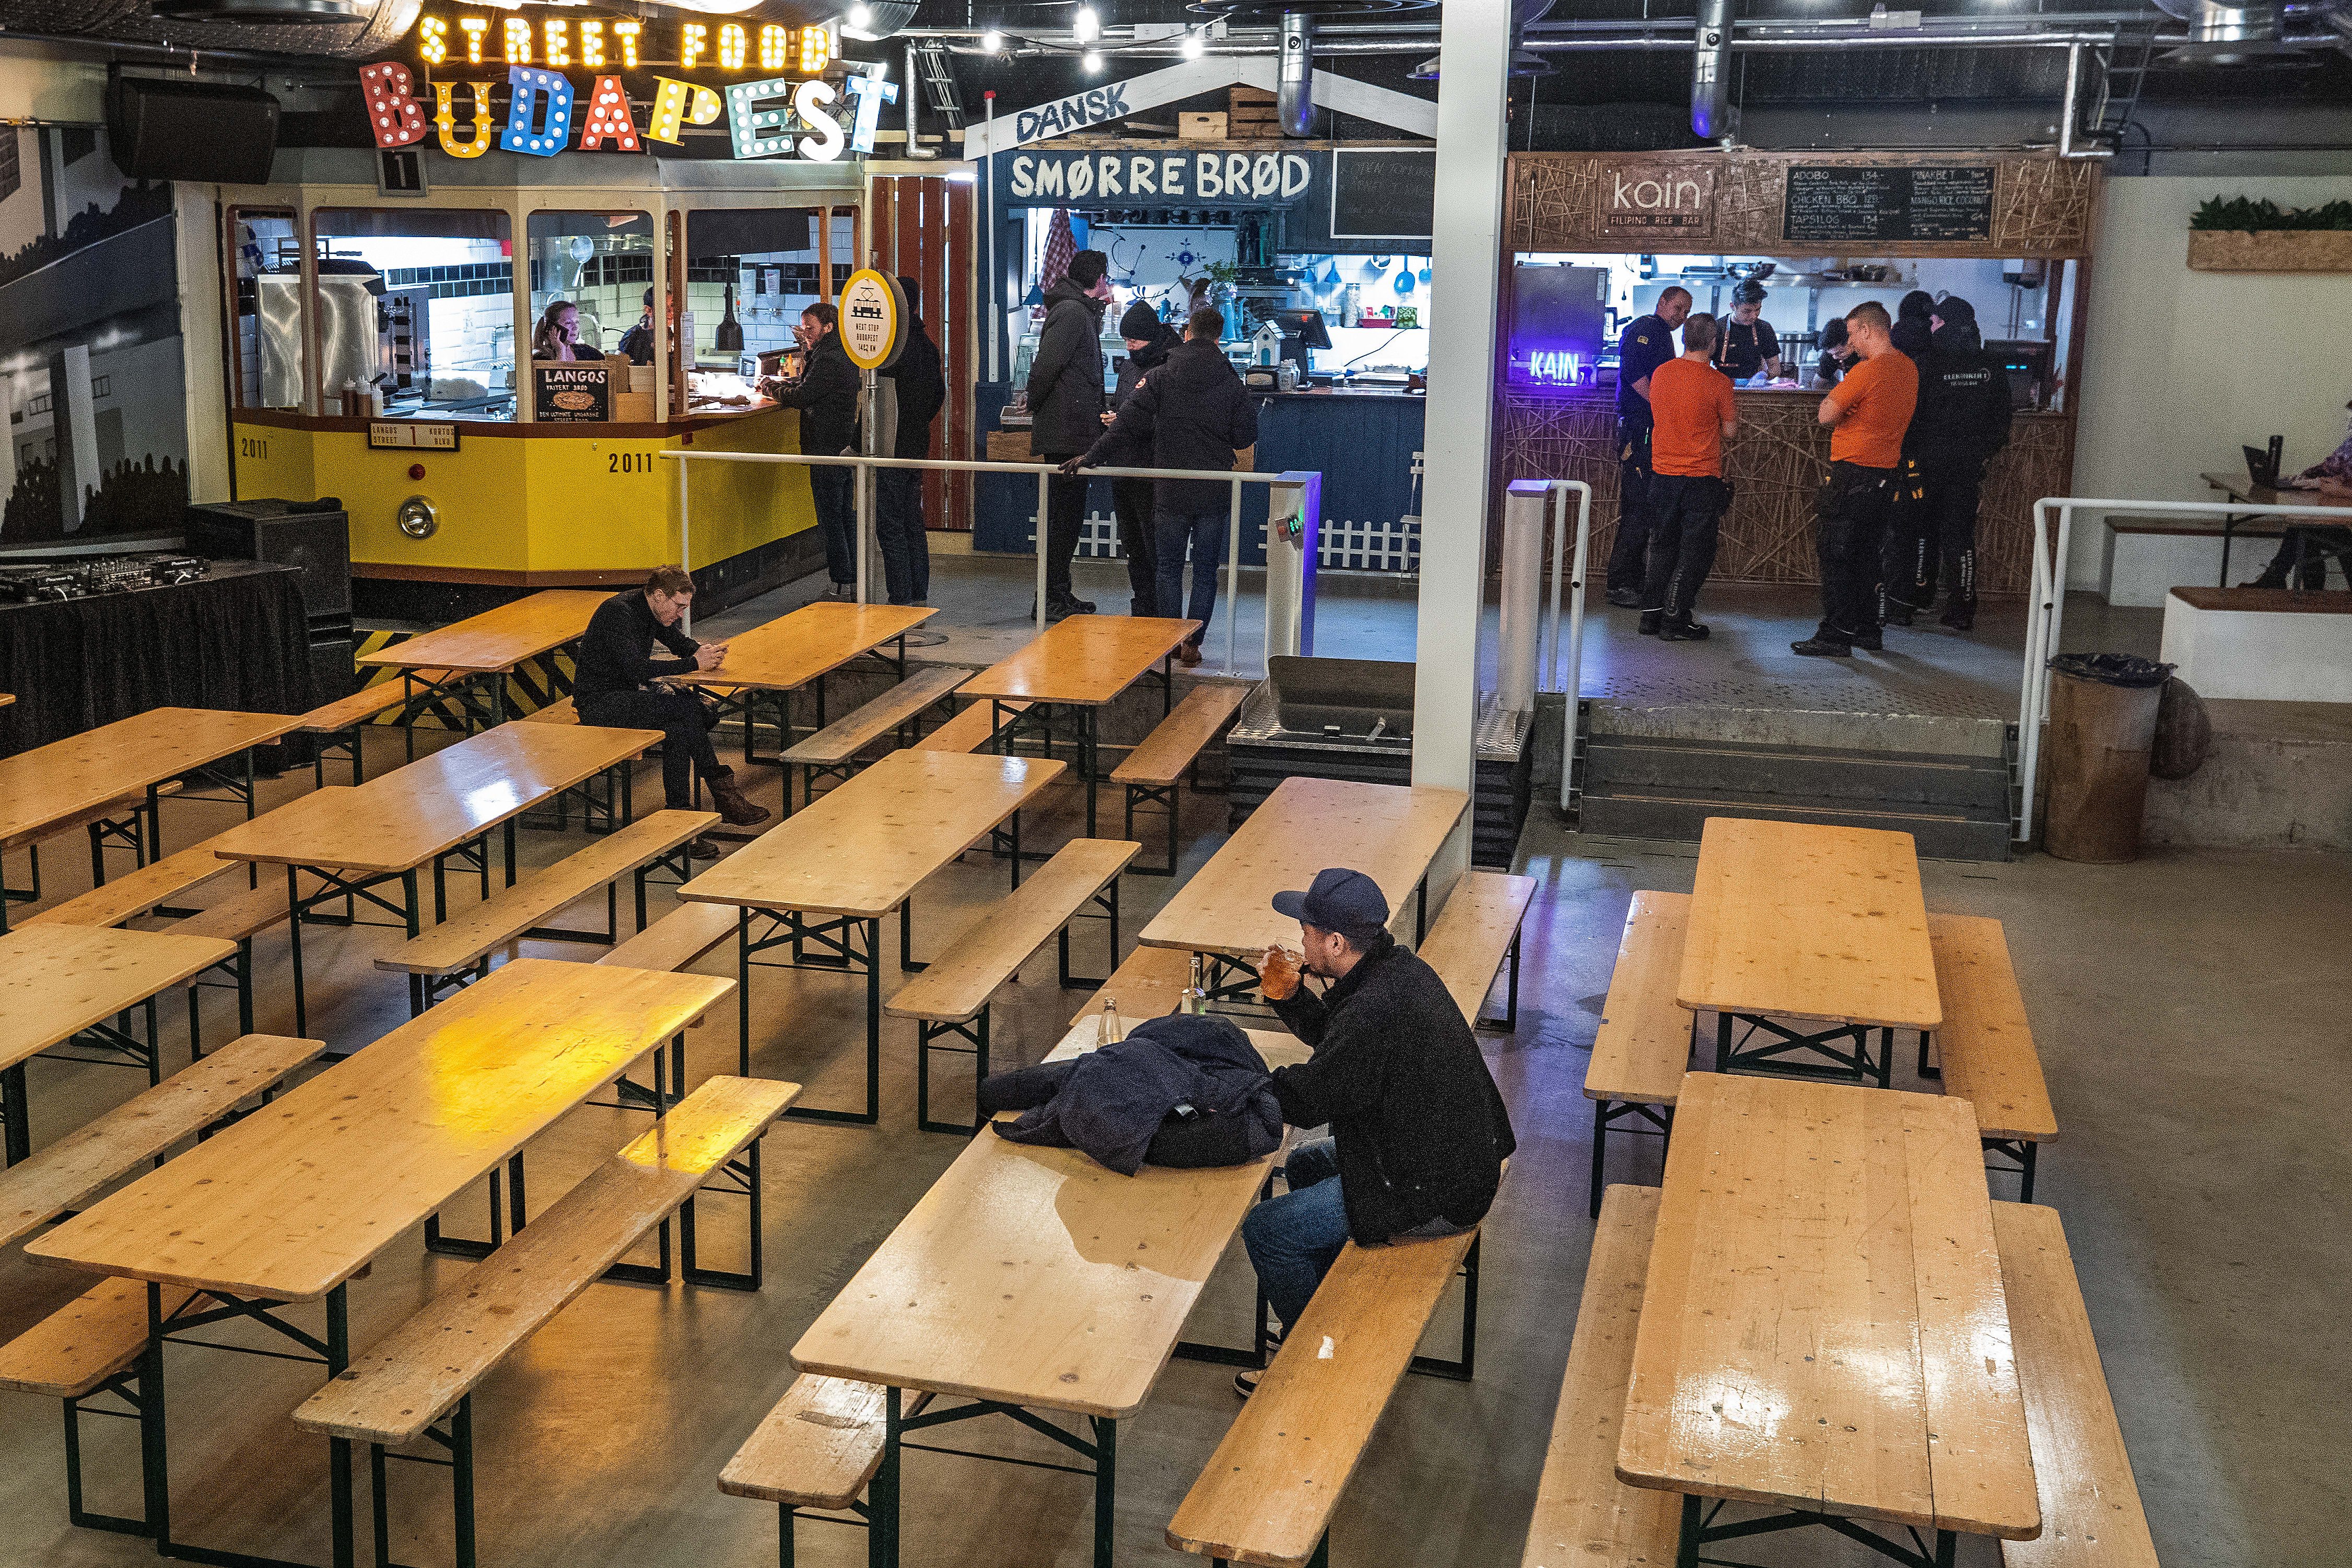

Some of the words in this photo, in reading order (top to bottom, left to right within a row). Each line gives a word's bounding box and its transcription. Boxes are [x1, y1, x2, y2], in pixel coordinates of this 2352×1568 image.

[419, 16, 640, 67] STREET
[682, 24, 829, 72] FOOD
[358, 62, 899, 161] BUDAPEST
[1016, 82, 1131, 143] DANSK
[393, 154, 407, 189] 1
[1793, 171, 1829, 180] ADOBO
[1614, 173, 1701, 209] kain
[1791, 195, 1831, 205] CHICKEN
[1836, 195, 1858, 204] BBQ
[1610, 216, 1647, 225] FILIPINO
[1654, 216, 1674, 225] RICE
[1682, 216, 1700, 225] BAR
[1791, 215, 1840, 224] TAPSILOG
[857, 333, 878, 342] BUDAPEST
[545, 370, 605, 383] LANGOS
[1530, 350, 1579, 383] KAIN
[372, 426, 397, 434] LANGOS
[410, 426, 417, 446] 1
[241, 438, 268, 460] 2011
[607, 453, 654, 473] 2011
